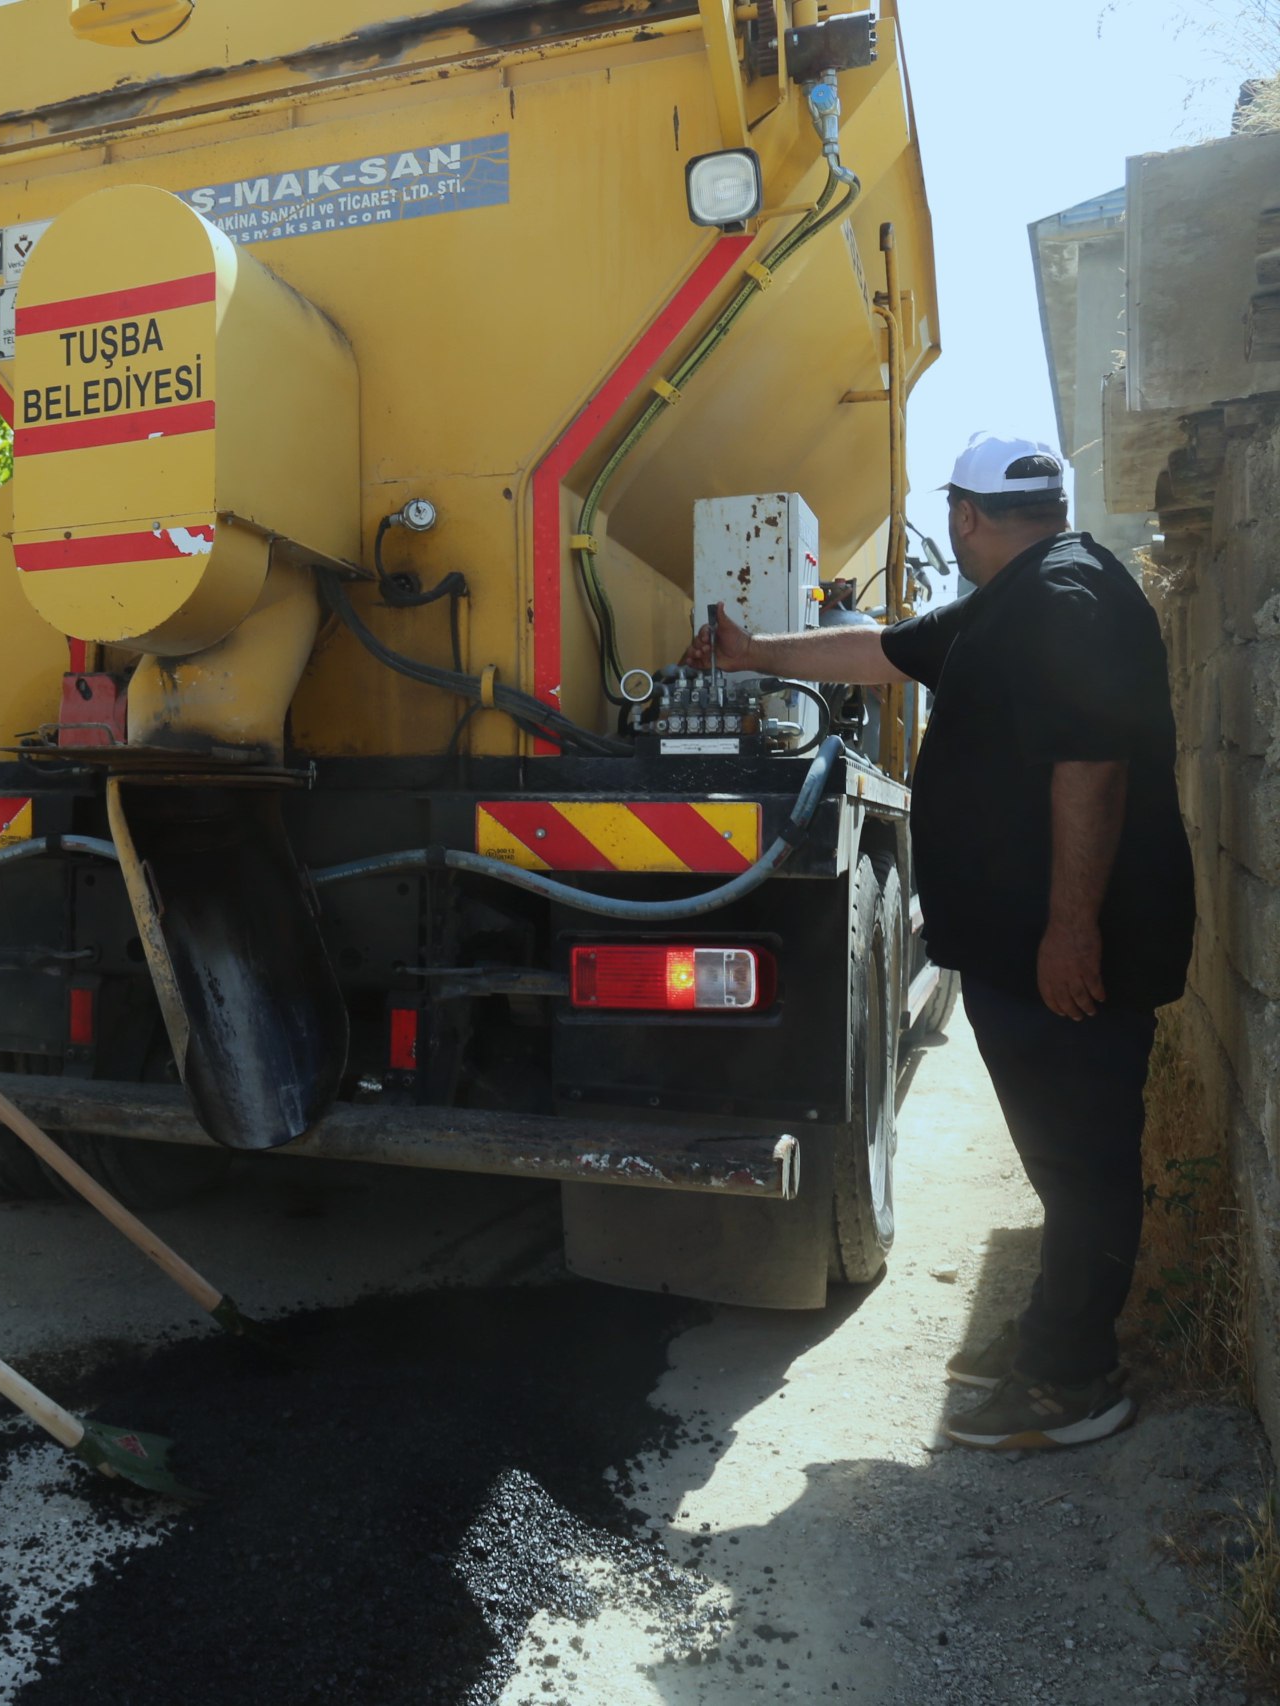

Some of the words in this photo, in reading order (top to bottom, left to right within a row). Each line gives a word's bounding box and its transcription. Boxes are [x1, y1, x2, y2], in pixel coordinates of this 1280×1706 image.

[319, 203, 333, 215] ve
[337, 189, 397, 212] TİCARET
[402, 183, 433, 202] LTD.
[437, 174, 466, 200] ŞTİ.
[60, 318, 163, 369] TUŞBA
[24, 353, 201, 423] BELEDİYESİ
